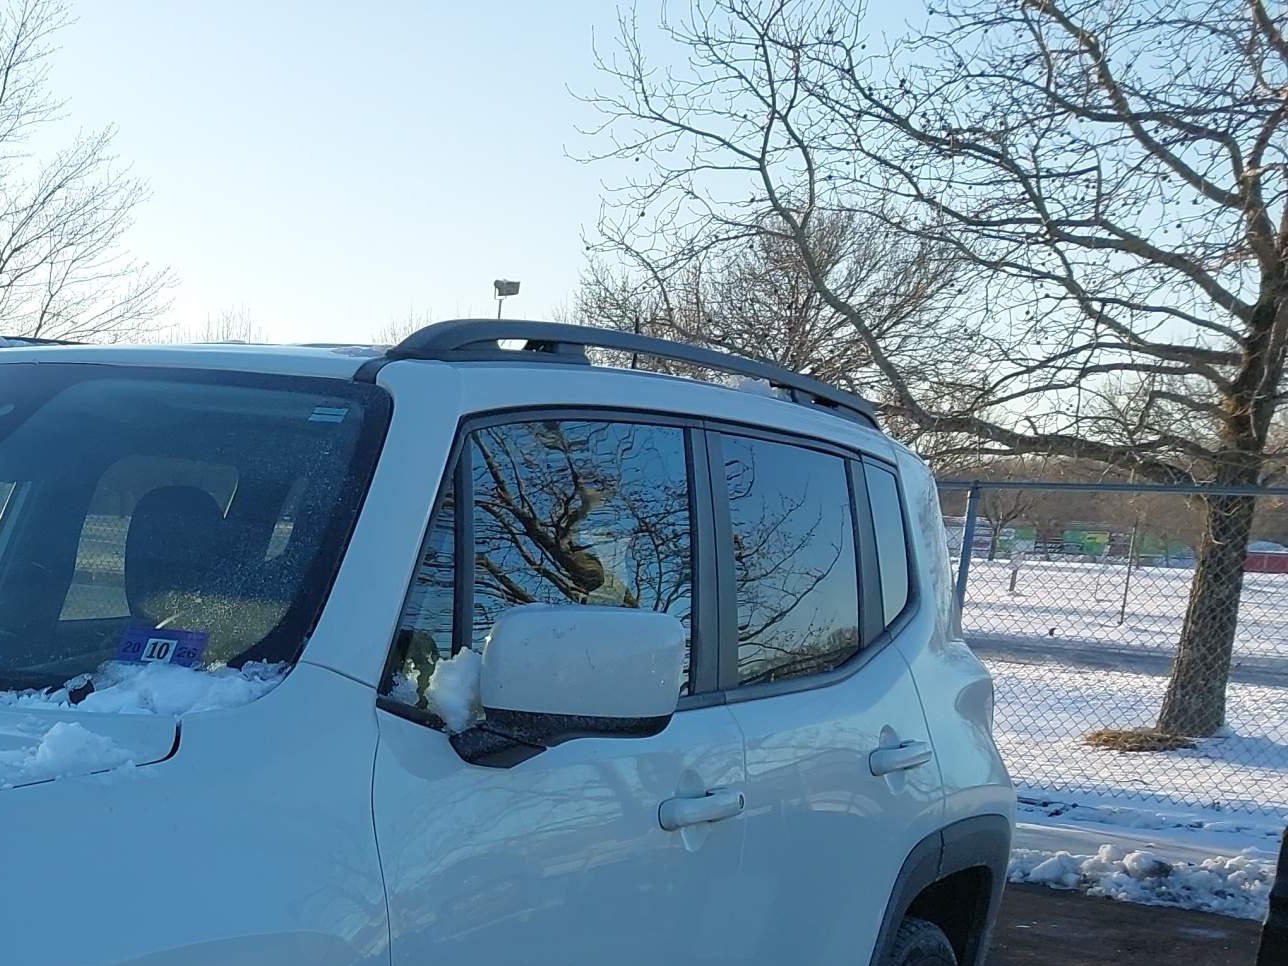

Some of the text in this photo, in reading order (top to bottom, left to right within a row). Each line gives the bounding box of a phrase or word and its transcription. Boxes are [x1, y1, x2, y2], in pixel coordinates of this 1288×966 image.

[122, 641, 197, 660] 20 10 26
